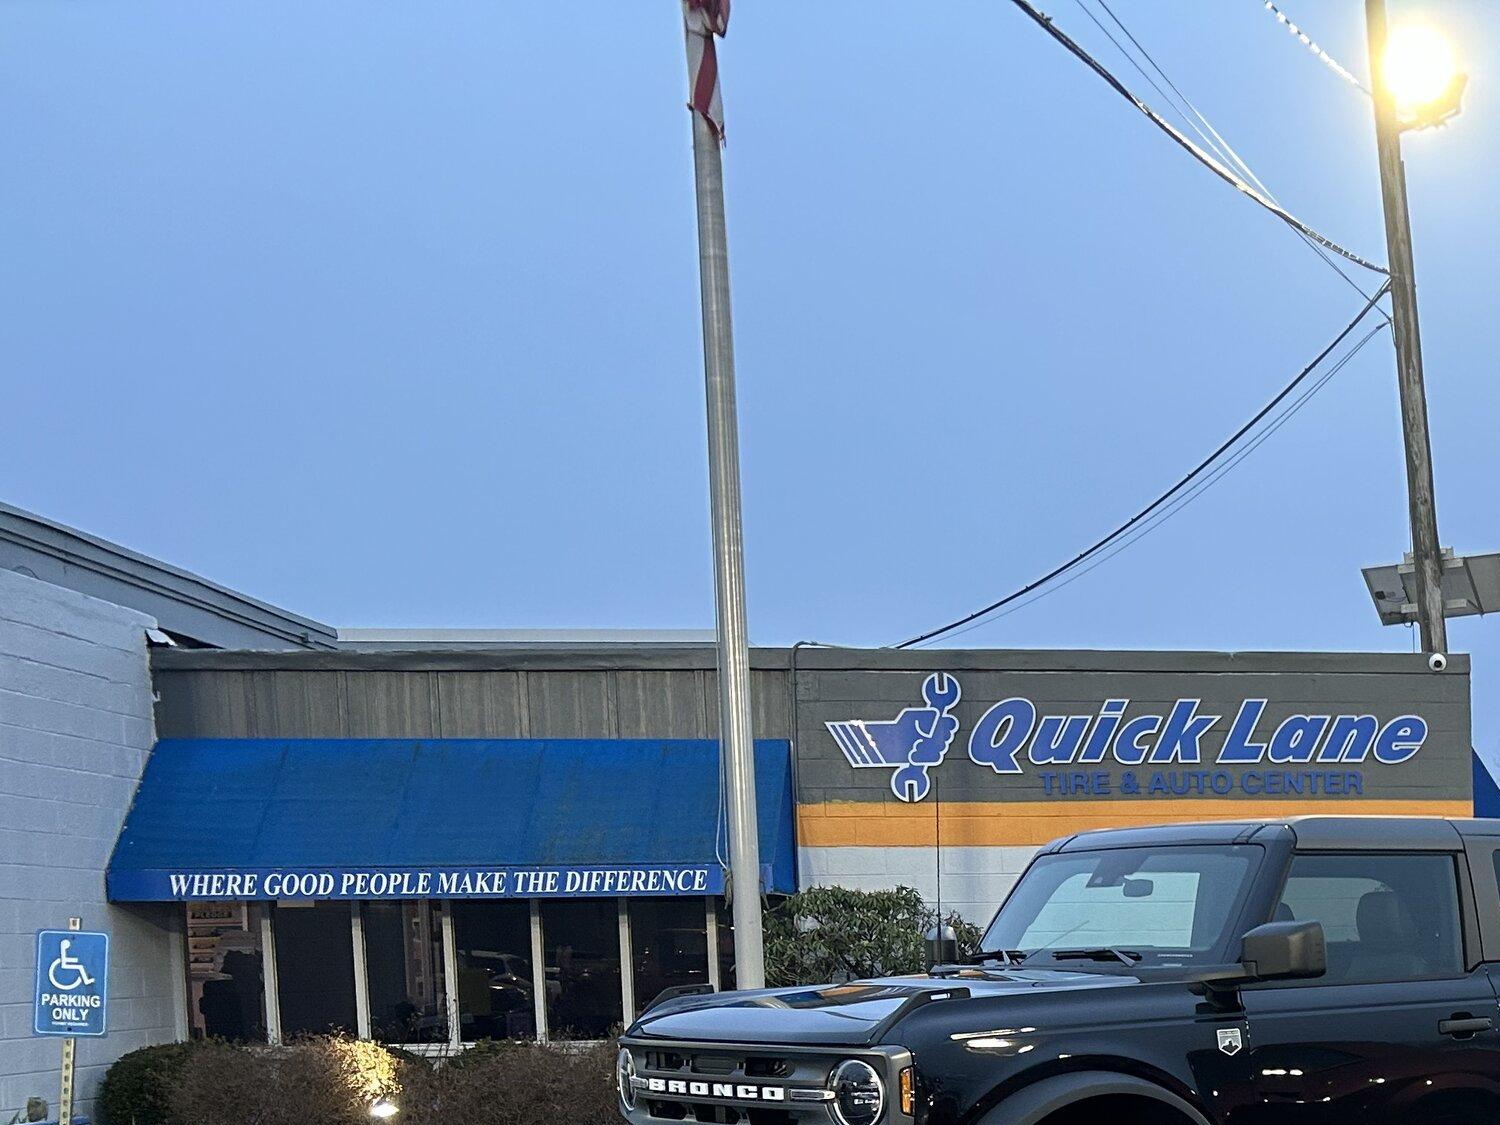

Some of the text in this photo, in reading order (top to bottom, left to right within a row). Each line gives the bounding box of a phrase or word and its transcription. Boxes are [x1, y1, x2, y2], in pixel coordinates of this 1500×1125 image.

[968, 697, 1429, 774] Quick Lane
[1039, 770, 1363, 795] TIRE & AUTO CENTER
[169, 869, 708, 896] WHERE GOOD PEOPLE MAKE THE DIFFERENCE
[41, 993, 101, 1008] PARKING
[52, 1007, 89, 1021] ONLY
[648, 1078, 785, 1101] BRONCO
